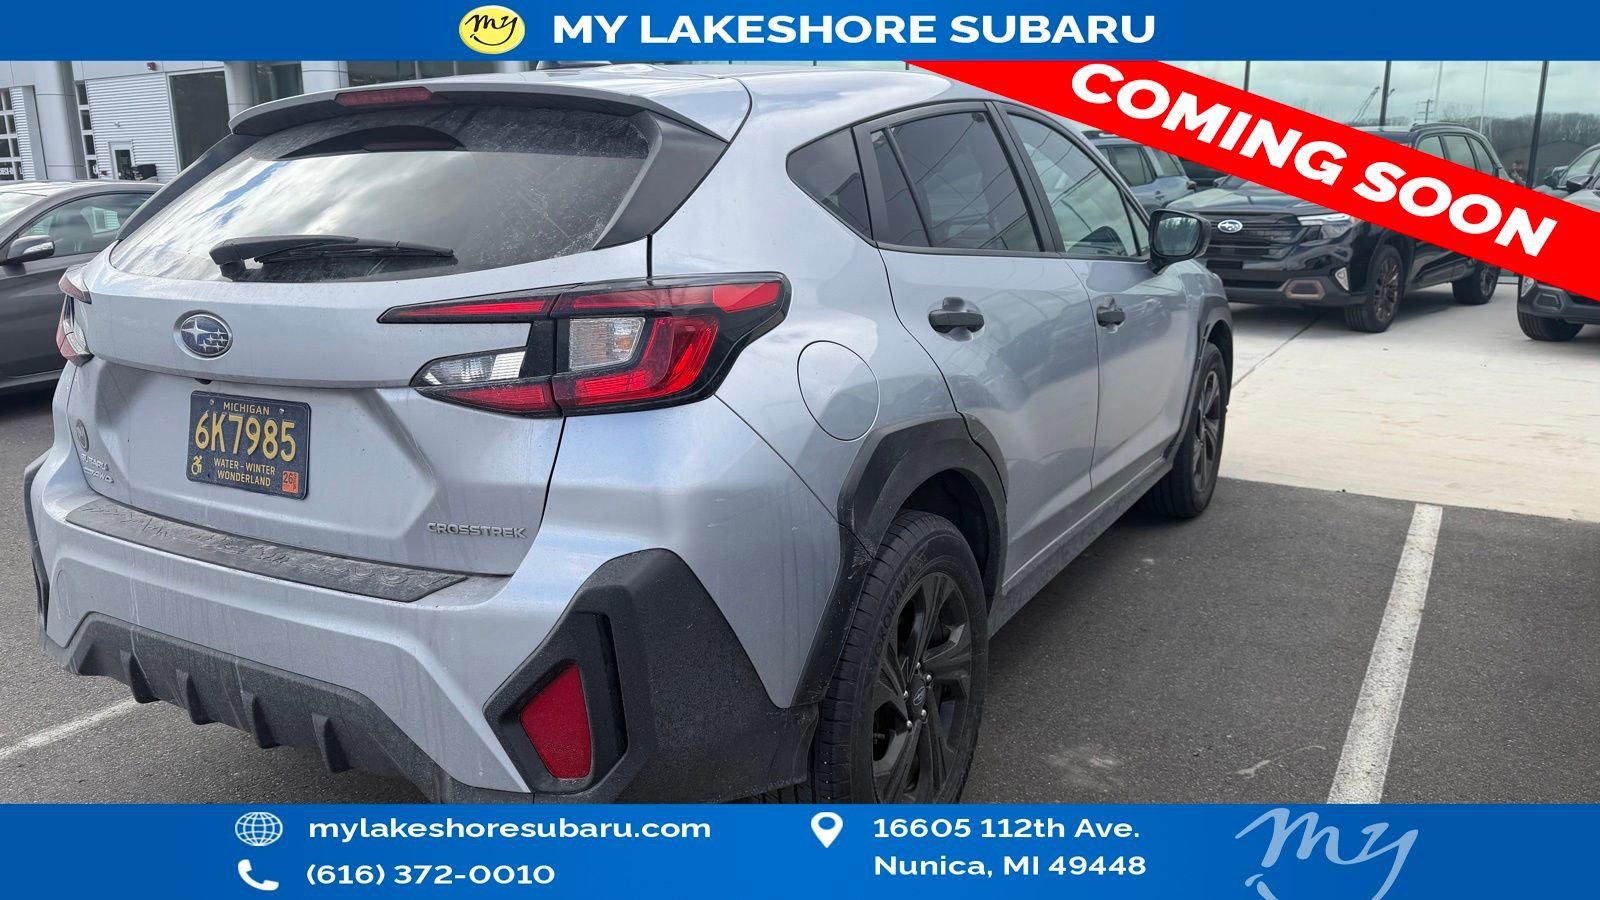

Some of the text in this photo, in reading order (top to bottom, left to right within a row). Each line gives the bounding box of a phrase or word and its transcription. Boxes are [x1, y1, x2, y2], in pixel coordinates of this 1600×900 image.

[223, 401, 270, 415] MICHIGAN
[194, 409, 297, 462] 6K7985
[217, 470, 271, 487] WONDERLAND
[283, 472, 293, 484] 26
[426, 522, 527, 538] CROSSTREK
